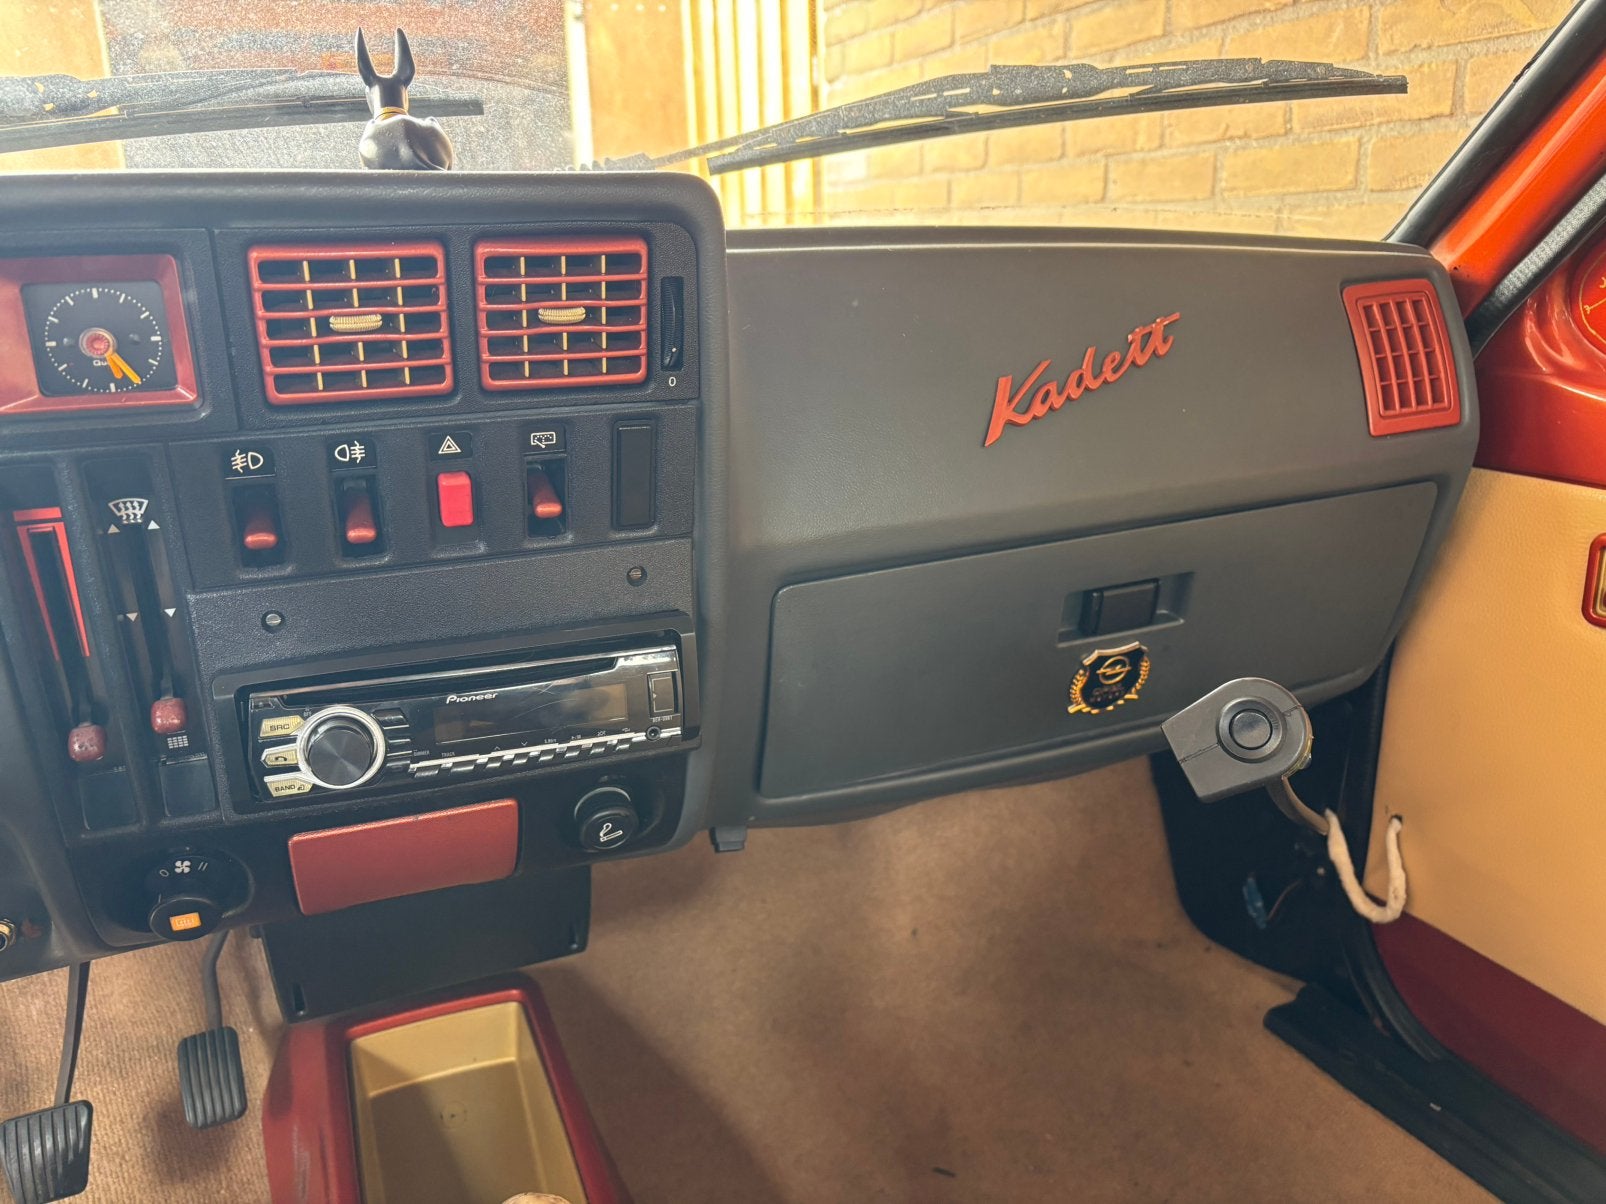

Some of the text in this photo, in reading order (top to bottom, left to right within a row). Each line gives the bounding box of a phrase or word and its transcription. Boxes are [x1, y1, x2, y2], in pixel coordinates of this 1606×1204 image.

[668, 376, 677, 387] 0
[983, 312, 1181, 448] Kadett
[445, 692, 499, 704] Pioneer
[269, 723, 290, 732] SRC
[274, 784, 296, 793] BAND
